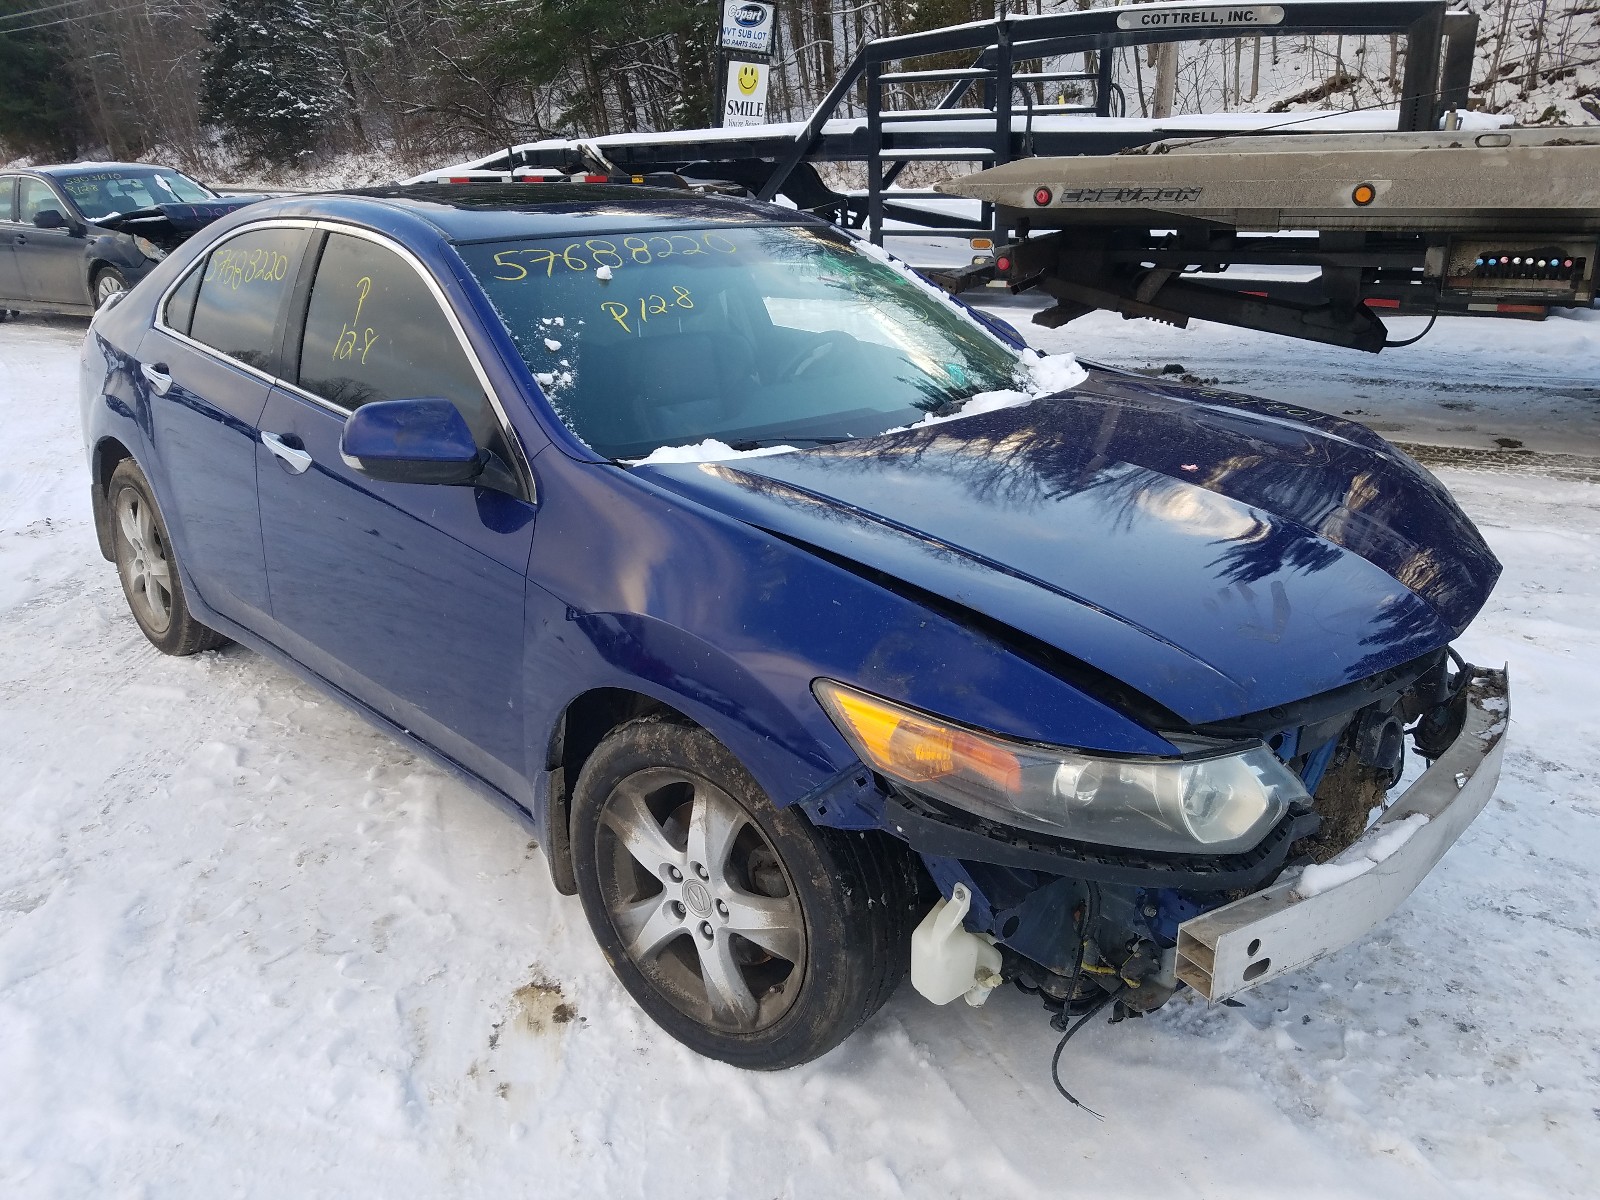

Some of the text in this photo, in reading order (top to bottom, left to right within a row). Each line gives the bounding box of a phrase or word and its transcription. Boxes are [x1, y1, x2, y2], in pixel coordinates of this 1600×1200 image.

[728, 5, 763, 21] Copart
[1141, 11, 1258, 26] COTTRELL, INC.
[738, 28, 752, 39] SUB
[754, 31, 767, 40] LOT
[731, 40, 749, 48] PARTS
[727, 99, 764, 117] SMILE
[1060, 186, 1203, 204] CHEVRON
[494, 233, 736, 281] 57688220
